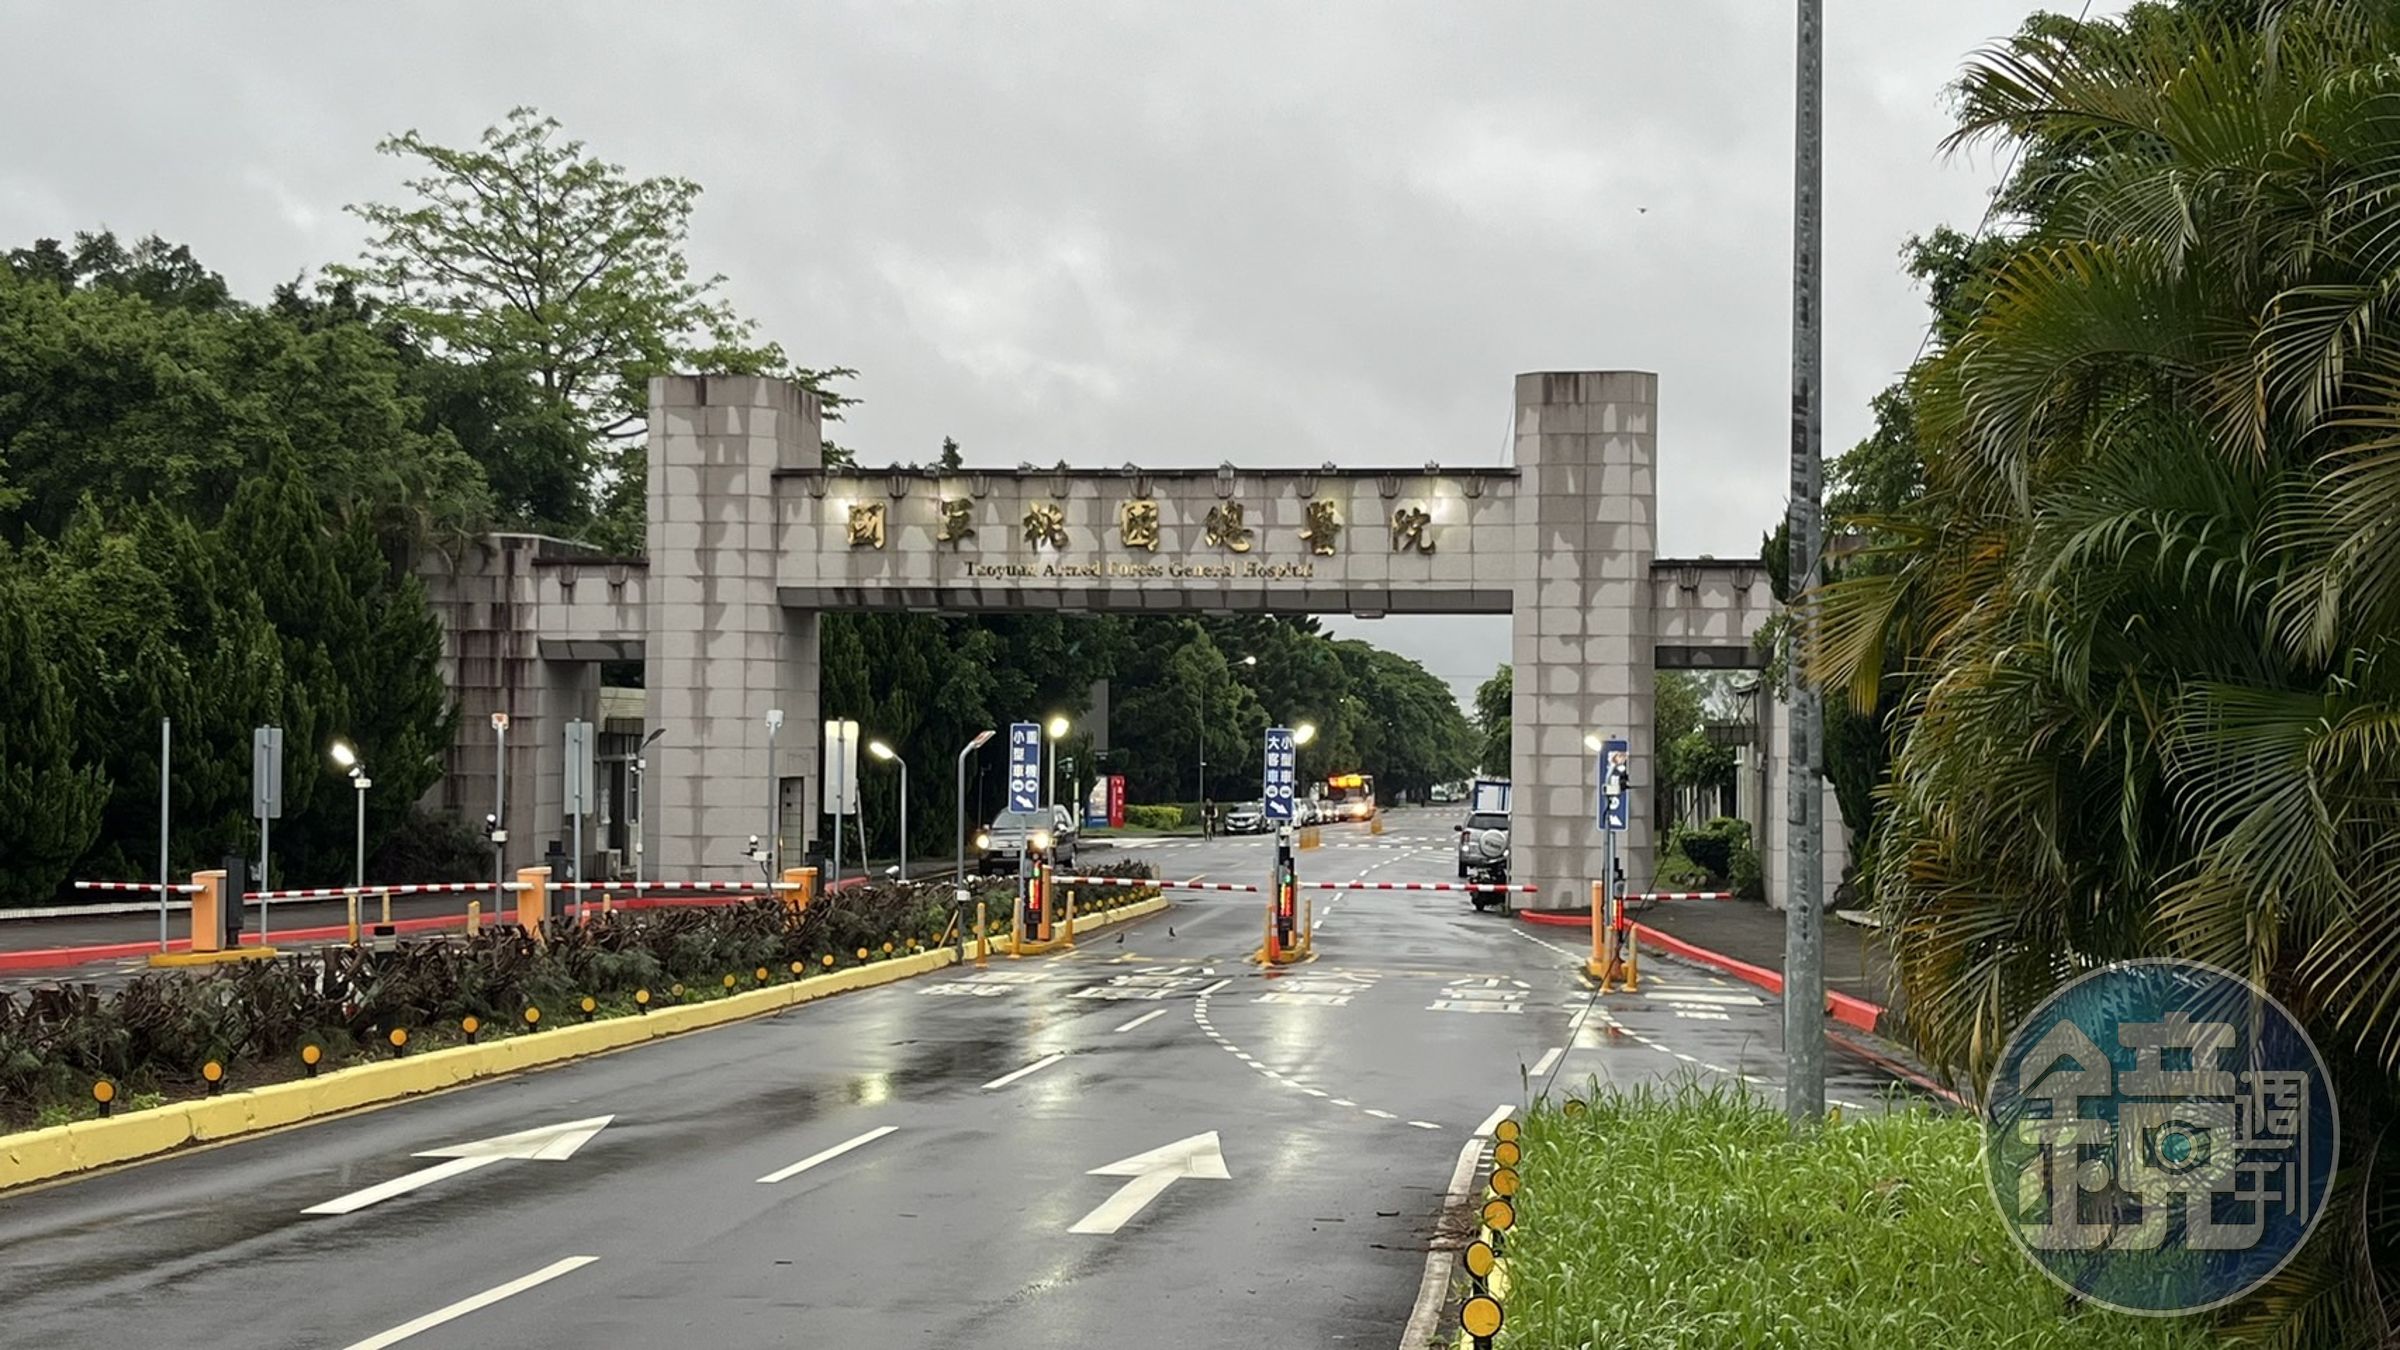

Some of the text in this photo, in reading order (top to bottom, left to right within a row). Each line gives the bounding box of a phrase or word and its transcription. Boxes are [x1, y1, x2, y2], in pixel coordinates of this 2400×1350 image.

[847, 498, 1436, 556] 國軍桃園總醫院
[966, 561, 1313, 581] Taoyuan Armed Forces General Hospital
[1268, 737, 1280, 784] 大客車
